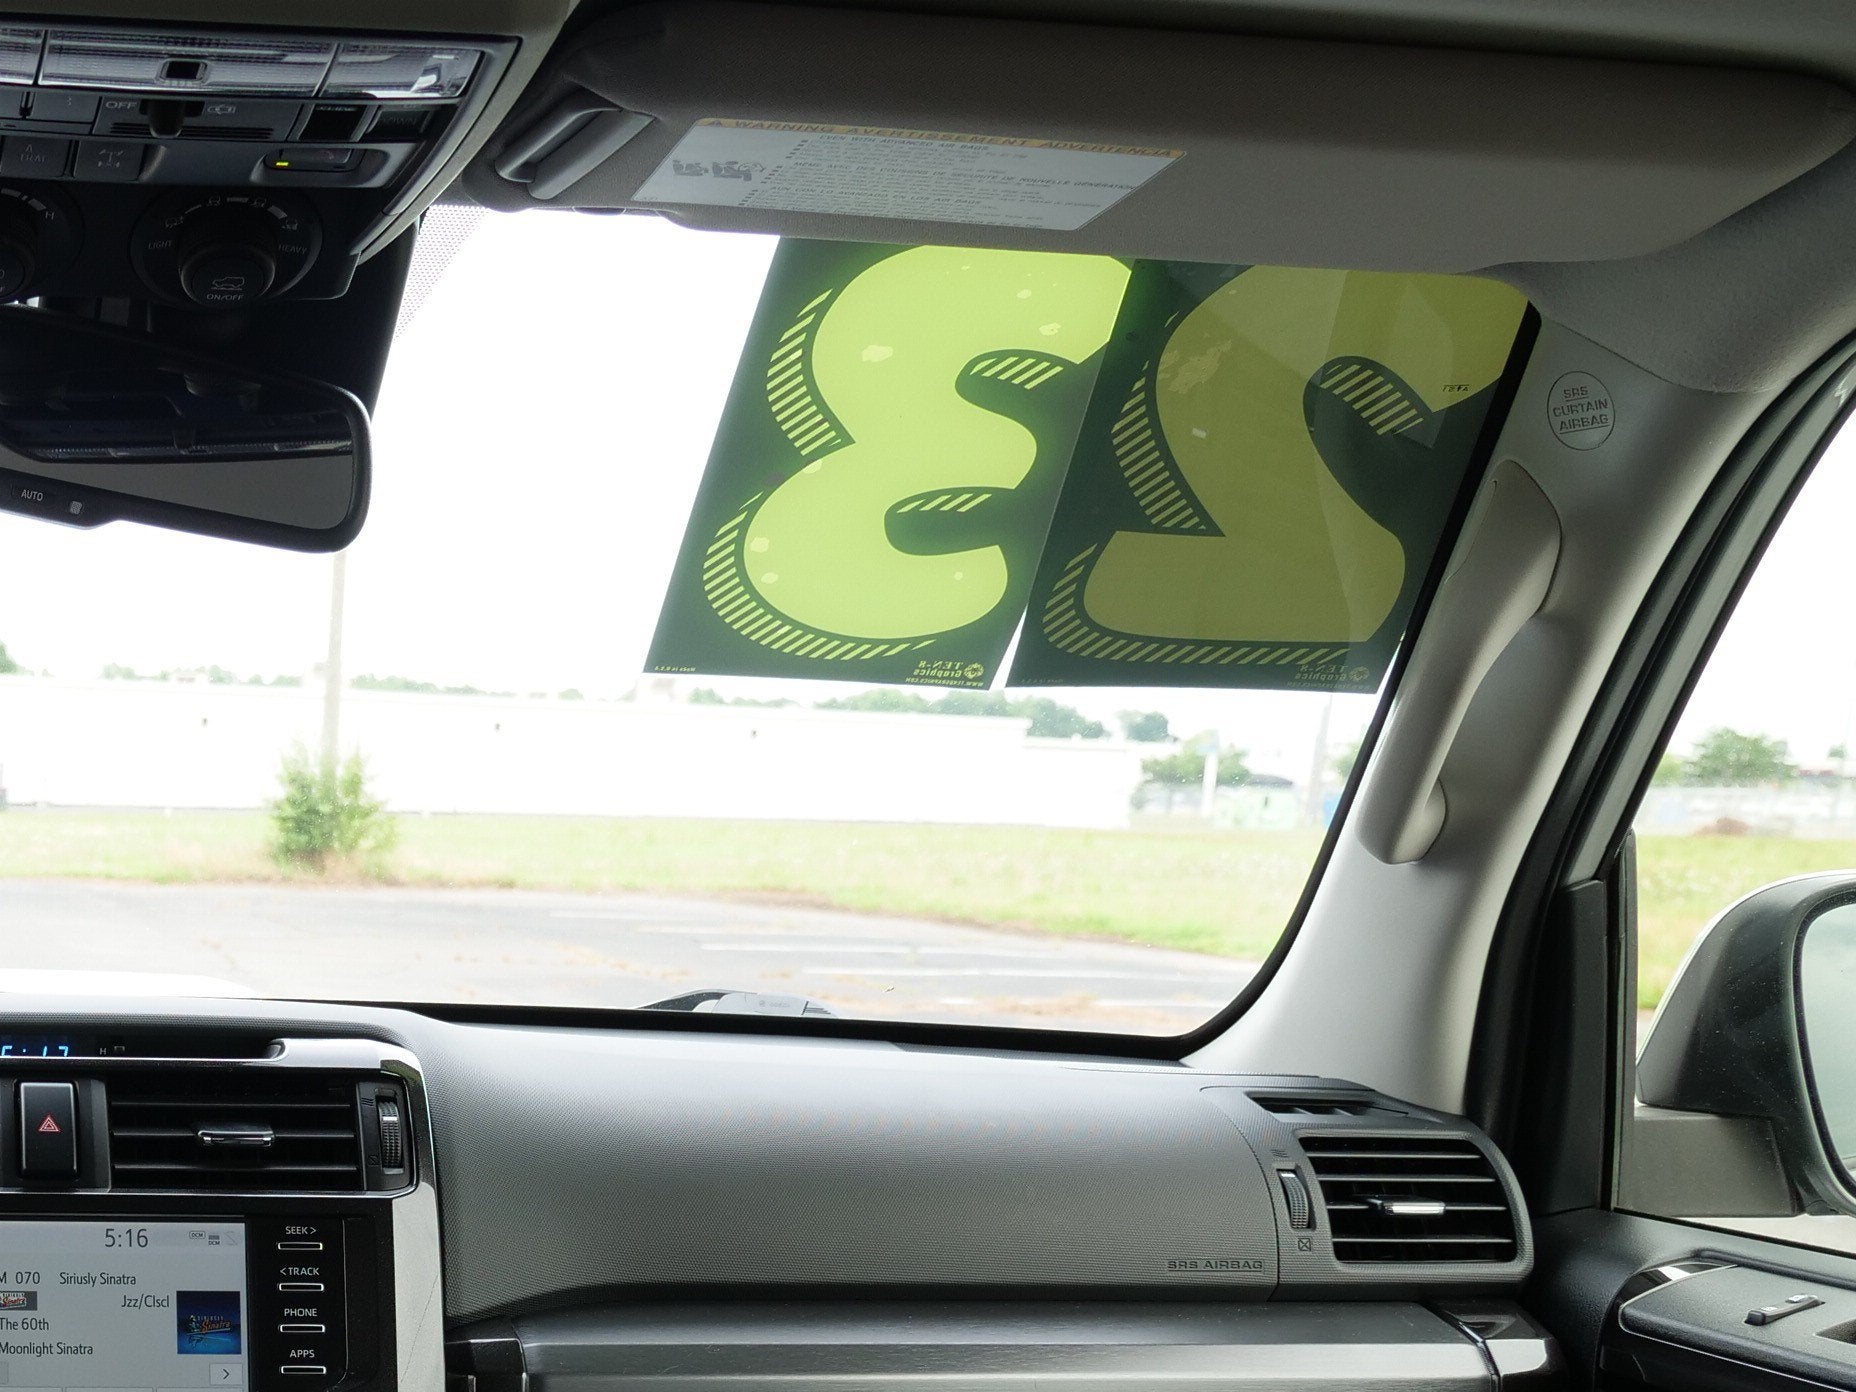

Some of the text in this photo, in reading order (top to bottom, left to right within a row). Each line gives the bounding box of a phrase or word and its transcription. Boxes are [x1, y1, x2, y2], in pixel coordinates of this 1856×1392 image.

[105, 101, 138, 109] OFF
[45, 211, 54, 220] H
[148, 240, 173, 249] LIGHT
[279, 244, 307, 256] HEAVY
[206, 293, 244, 301] ON/OFF
[1563, 386, 1589, 399] SRS
[1553, 398, 1608, 417] CURTAIN
[1559, 414, 1609, 431] AIRBAG
[21, 489, 43, 501] AUTO
[104, 1228, 149, 1248] 5:16
[1167, 1260, 1263, 1269] SRS AIRBAG
[15, 1271, 41, 1285] 070
[59, 1271, 137, 1288] Siriusly Sinatra
[284, 1308, 318, 1317] PHONE
[21, 1317, 50, 1331] 60th
[56, 1341, 94, 1355] Sinatra
[289, 1349, 315, 1358] APPS
